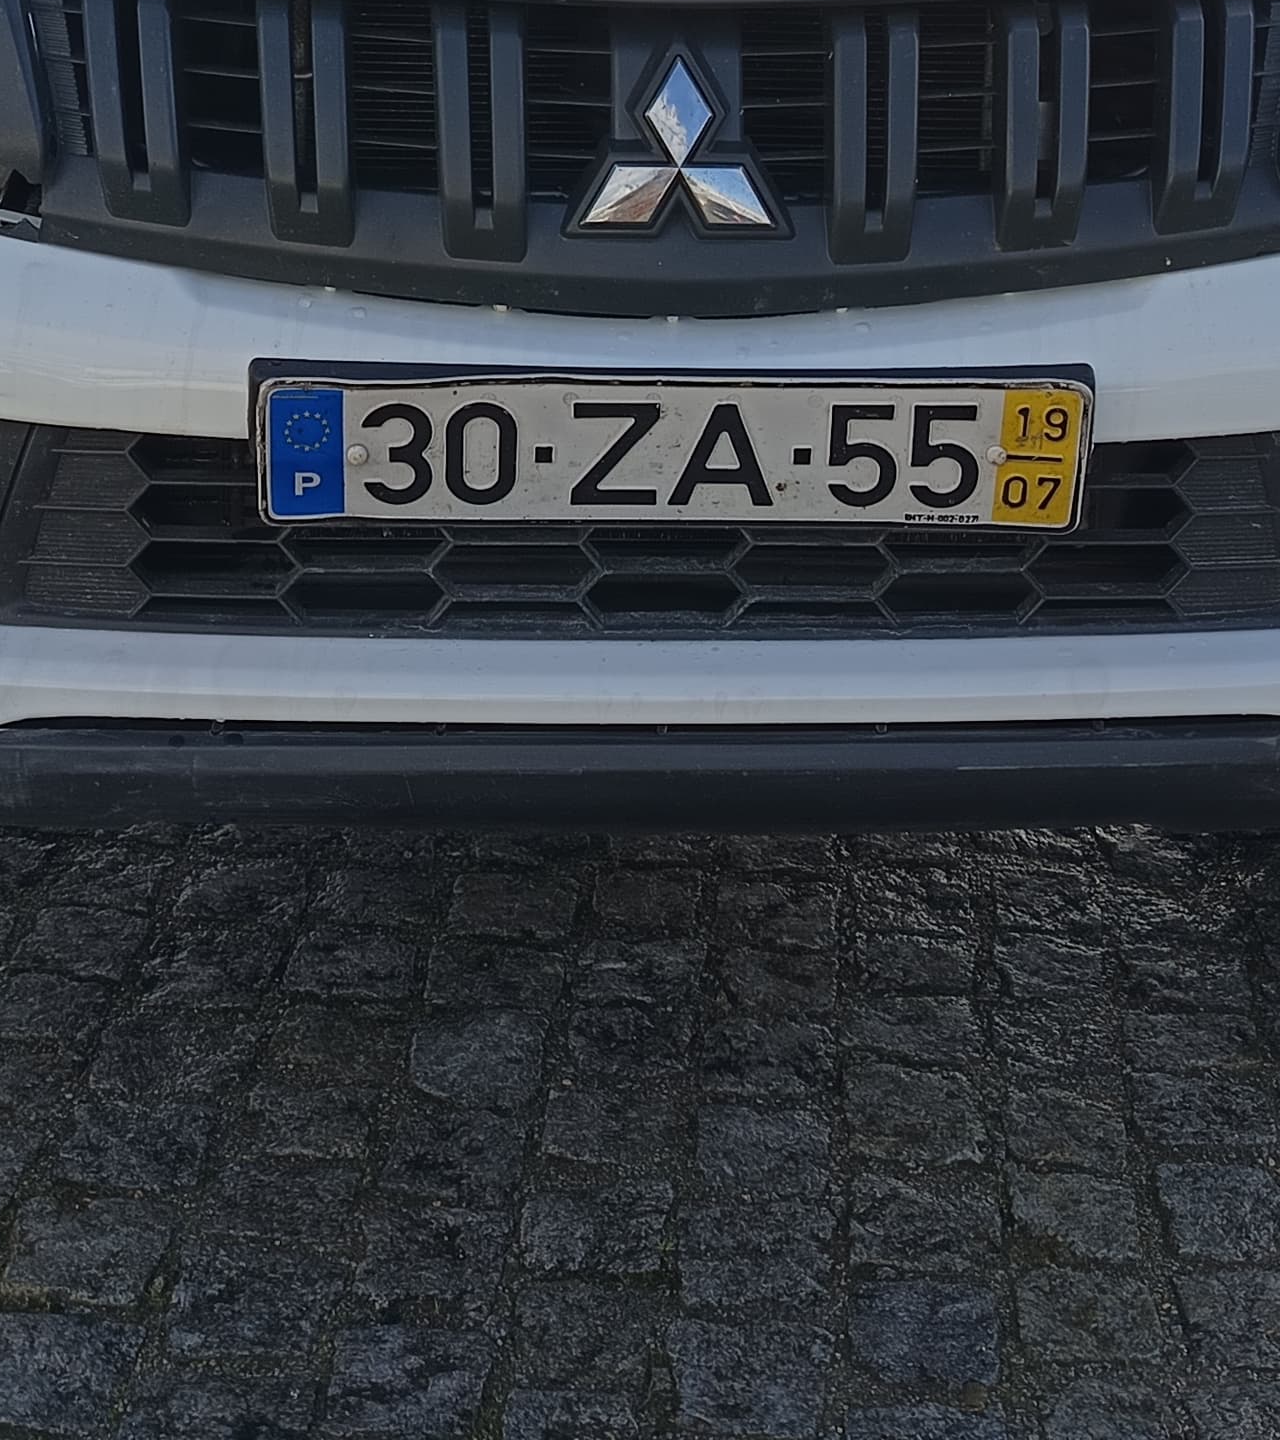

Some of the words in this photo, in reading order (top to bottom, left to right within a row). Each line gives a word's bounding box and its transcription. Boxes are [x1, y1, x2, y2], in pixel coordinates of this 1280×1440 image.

[1017, 406, 1069, 442] 19
[294, 471, 321, 496] P
[1001, 475, 1062, 511] 07
